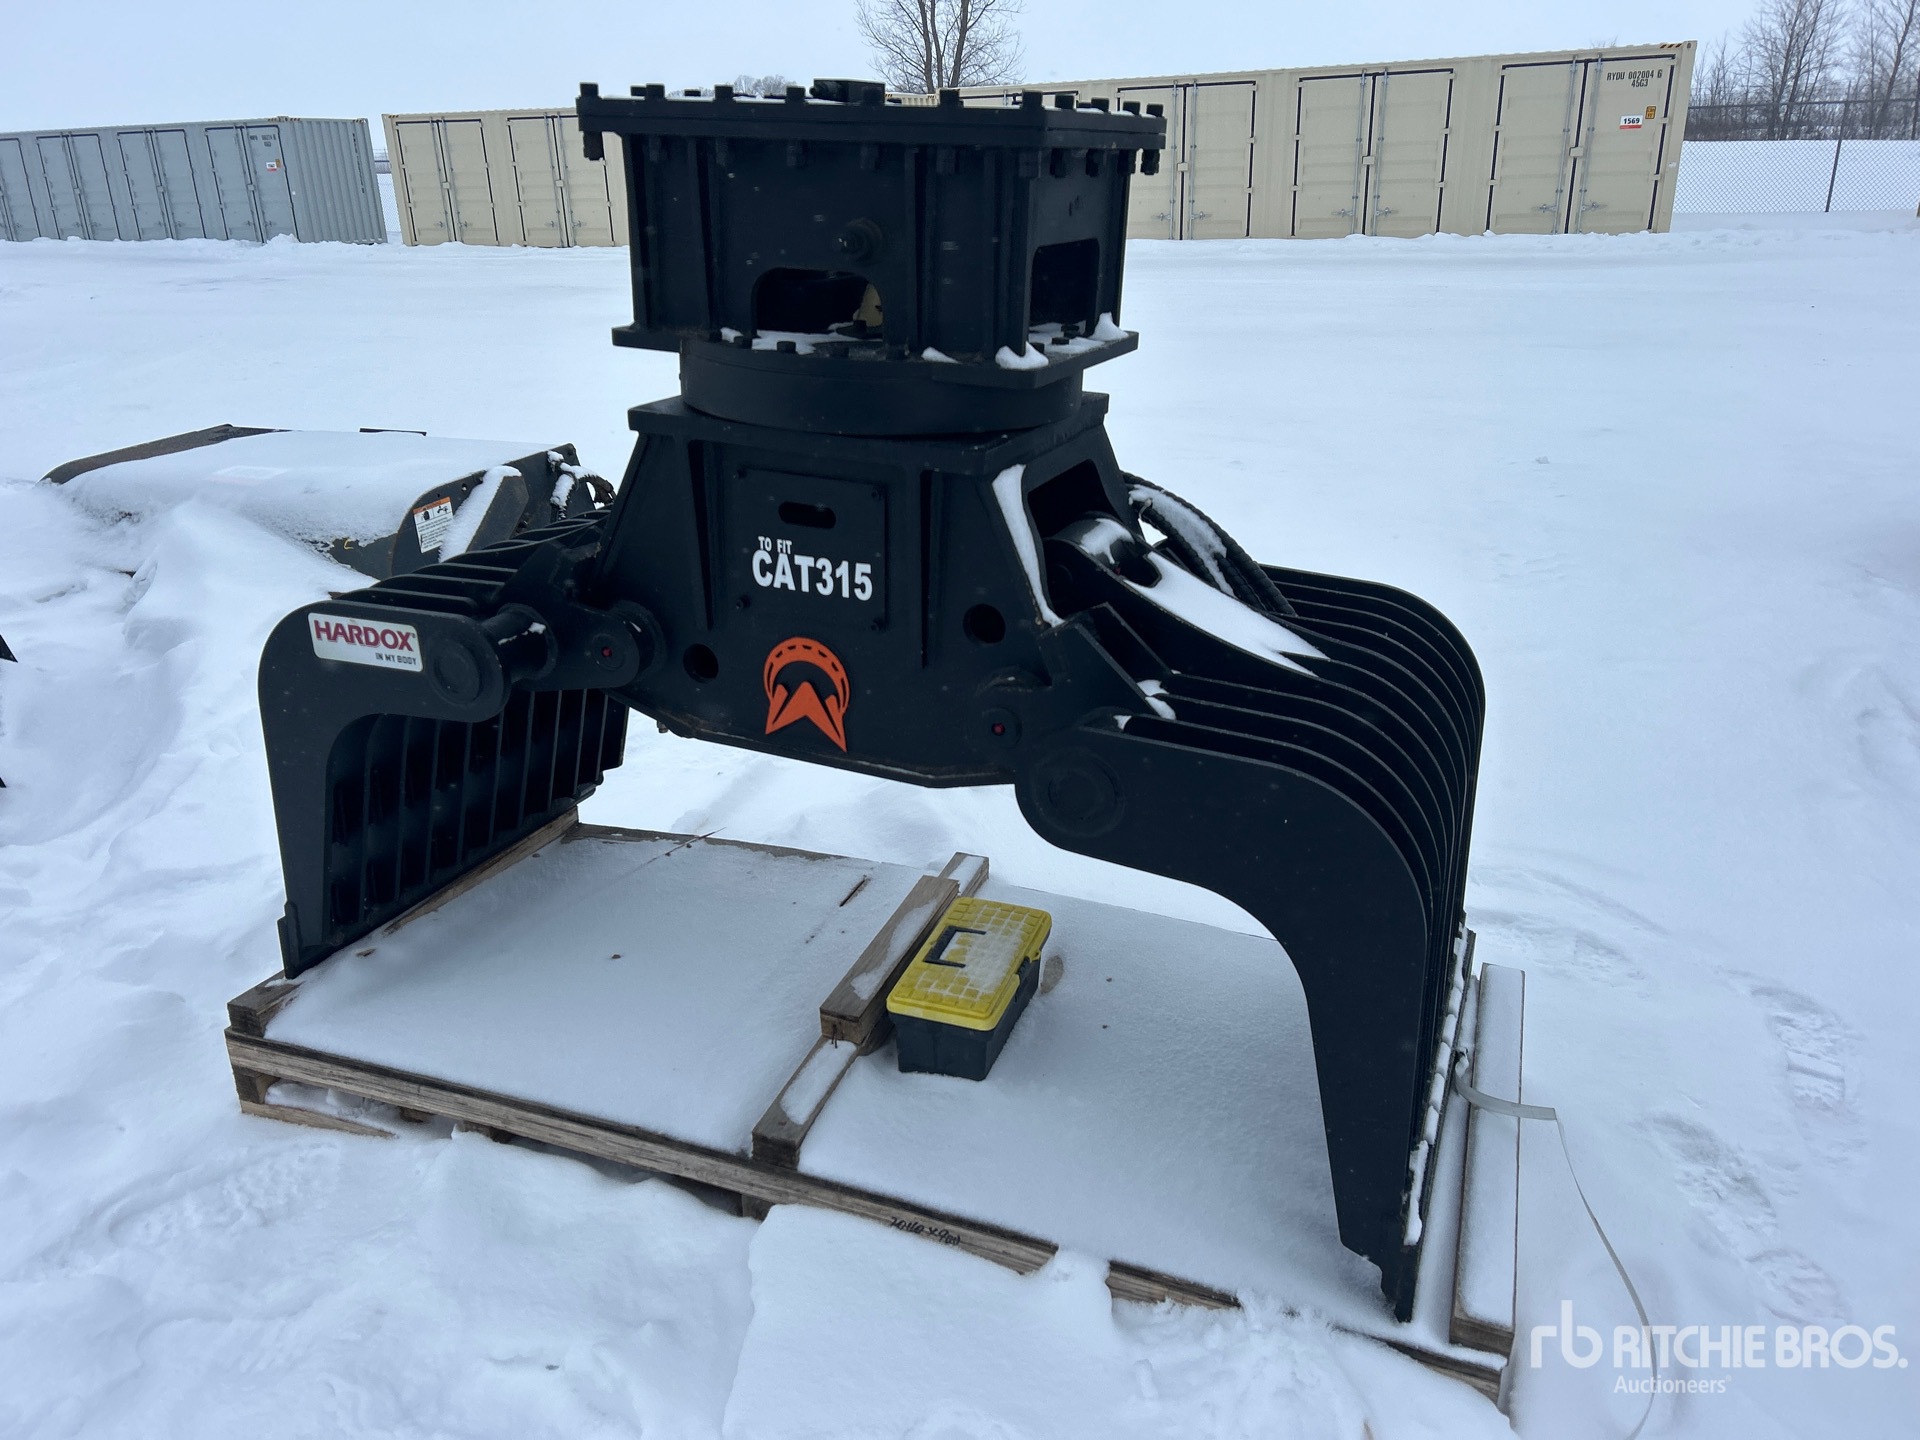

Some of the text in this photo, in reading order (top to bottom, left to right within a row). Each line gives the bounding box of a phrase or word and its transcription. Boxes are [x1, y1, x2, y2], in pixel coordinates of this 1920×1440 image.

[1628, 69, 1654, 79] 002004
[758, 536, 792, 554] TO FIT
[752, 549, 873, 601] CAT315
[375, 652, 417, 666] IN MY BODY
